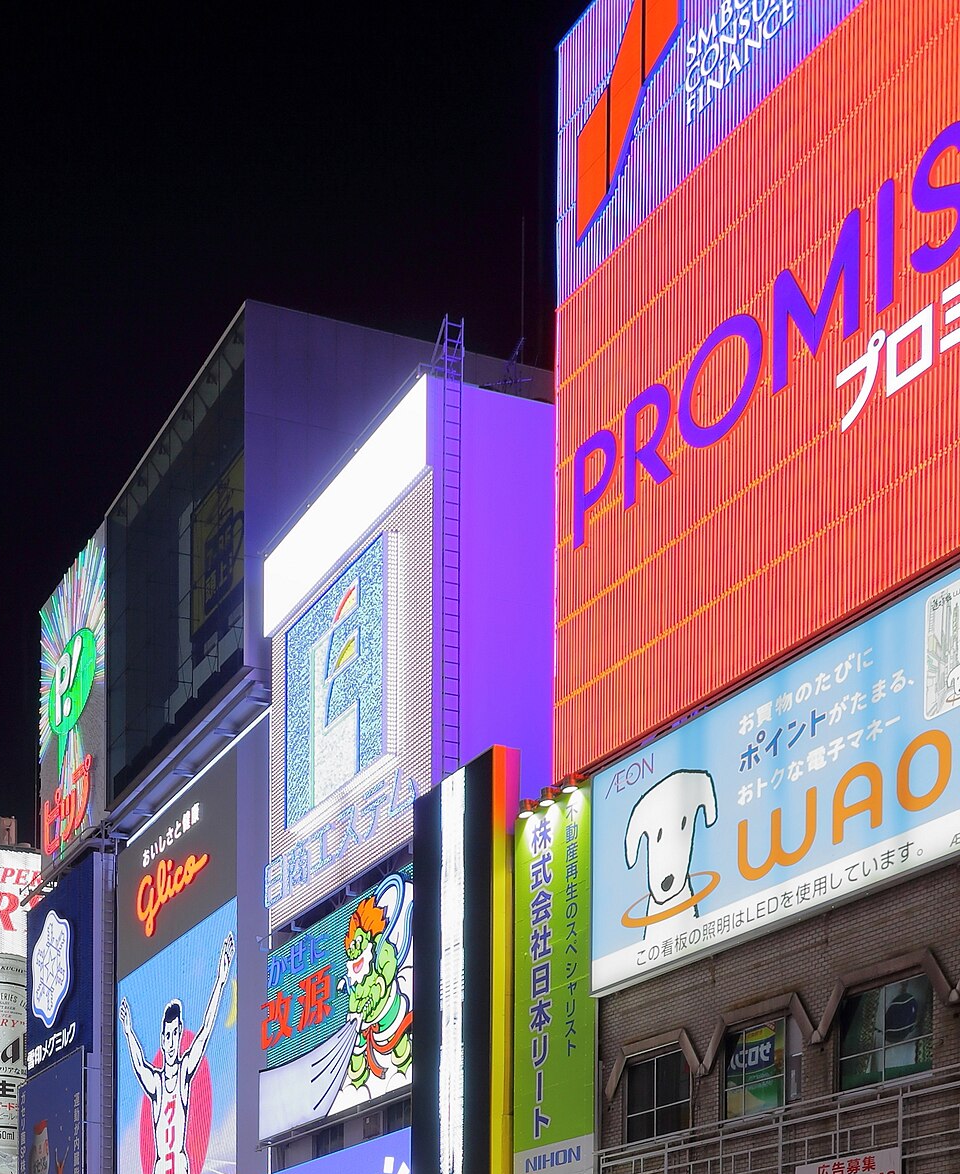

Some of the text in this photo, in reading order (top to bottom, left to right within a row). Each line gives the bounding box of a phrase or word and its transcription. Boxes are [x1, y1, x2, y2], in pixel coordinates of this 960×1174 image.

[686, 0, 752, 68] SMB
[738, 647, 874, 736] お買物のたびに
[43, 754, 93, 856] ピップ
[737, 715, 901, 806] おトクな電子マネー
[565, 803, 580, 1058] 不動産再生のスペシャリスト
[635, 842, 925, 966] この看板の照明はLEDを使用しています。
[268, 935, 328, 987] かぜに
[529, 817, 553, 1141] 株式会社日本リート
[27, 1022, 76, 1070] 雪印メグミルク
[261, 964, 333, 1051] 改源
[525, 1145, 581, 1173] NIHON
